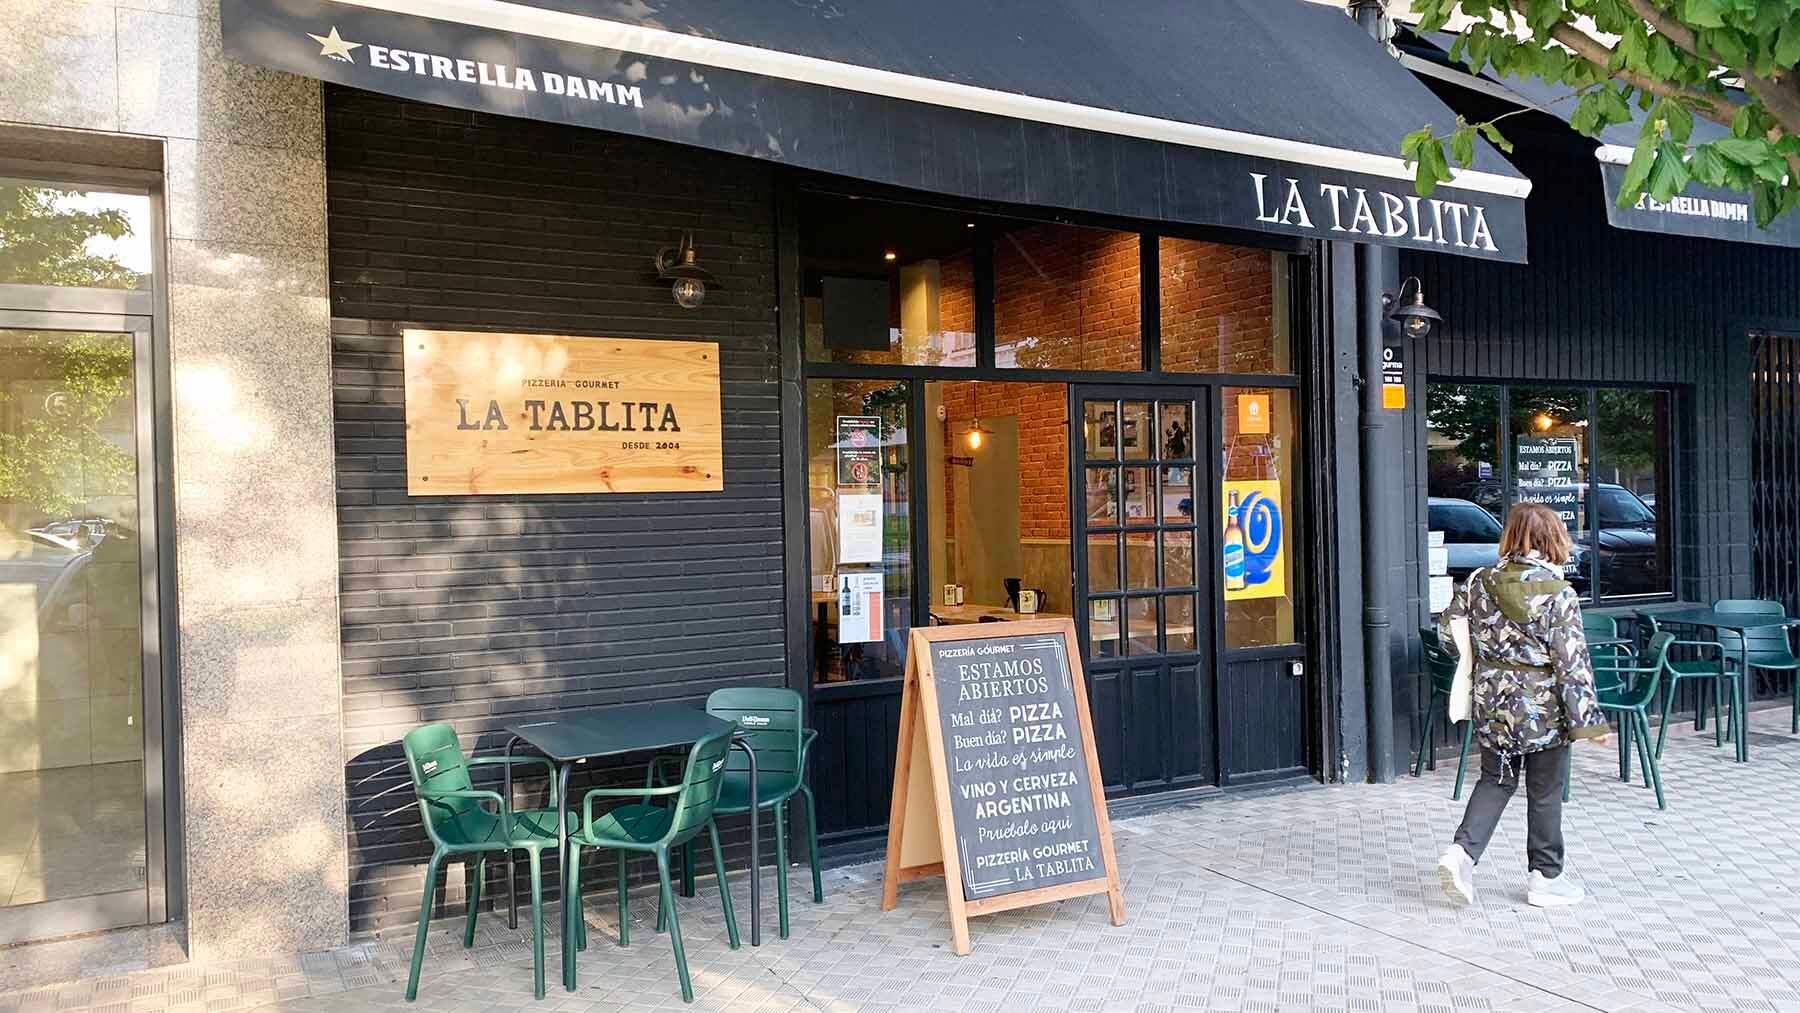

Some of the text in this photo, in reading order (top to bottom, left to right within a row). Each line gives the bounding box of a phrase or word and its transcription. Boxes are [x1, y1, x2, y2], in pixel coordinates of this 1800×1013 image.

[368, 44, 644, 109] ESTRELLA DAMM
[1250, 172, 1499, 252] LA TABLITA
[521, 379, 619, 390] PIZZERIA GOURMET
[456, 398, 681, 433] LA TABLITA
[622, 441, 680, 451] DESDE 2004
[1519, 446, 1545, 454] ESTAMOS
[1548, 460, 1573, 471] PIZZA
[1547, 477, 1573, 488] PIZZA
[958, 658, 1044, 682] ESTAMOS
[958, 677, 1049, 702] ABIERTOS
[951, 711, 974, 727] Mal
[1008, 702, 1064, 723] PIZZA
[954, 723, 1067, 750] Buen día? PIZZA
[955, 756, 975, 772] La
[974, 752, 1010, 769] vida
[1029, 743, 1076, 764] simple
[960, 770, 1079, 799] VINO Y CERVEZA
[975, 791, 1072, 820] ARGENTINA
[976, 839, 1089, 869] PIZZERÍA GOURMET
[1015, 856, 1096, 883] LA TABLITA
